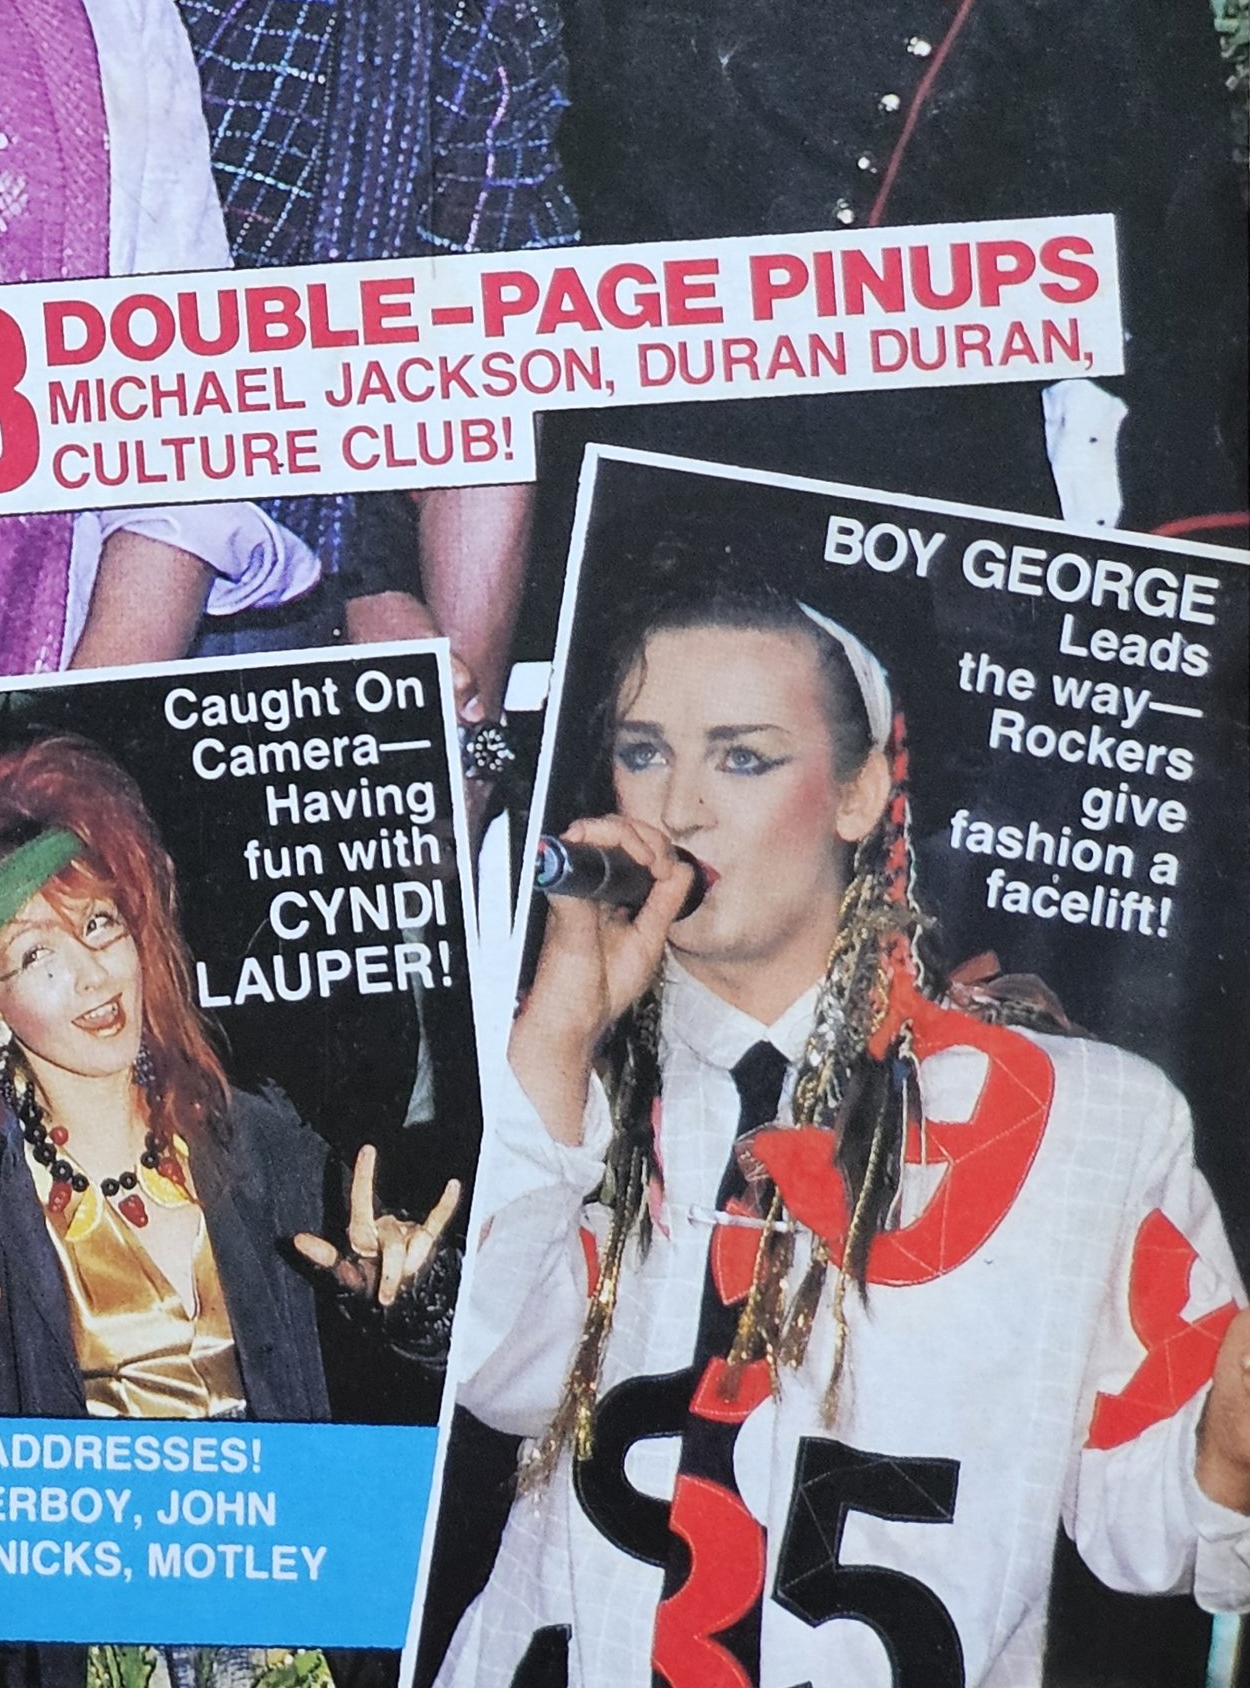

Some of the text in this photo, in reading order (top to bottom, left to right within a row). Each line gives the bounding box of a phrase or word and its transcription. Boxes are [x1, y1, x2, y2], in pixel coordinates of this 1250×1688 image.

[750, 236, 1099, 320] PINUPS
[49, 318, 1094, 425] MICHAEL JACKSON, DURAN DURAN,
[52, 416, 514, 490] CULTURE CLUB!
[824, 515, 1221, 625] BOY GEORGE
[1059, 613, 1210, 677] Leads
[164, 670, 425, 731] Caught On
[958, 653, 1036, 702] the
[989, 709, 1194, 782] Rockers
[266, 778, 436, 826] Having
[1082, 783, 1188, 834] give
[245, 828, 441, 881] fun with
[951, 810, 1180, 886] fashion a
[269, 881, 447, 940] CYNDI
[987, 869, 1173, 939] facelift!
[195, 941, 453, 1009] LAUPER!
[156, 1491, 276, 1528] JOHN
[148, 1543, 327, 1582] MOTLEY
